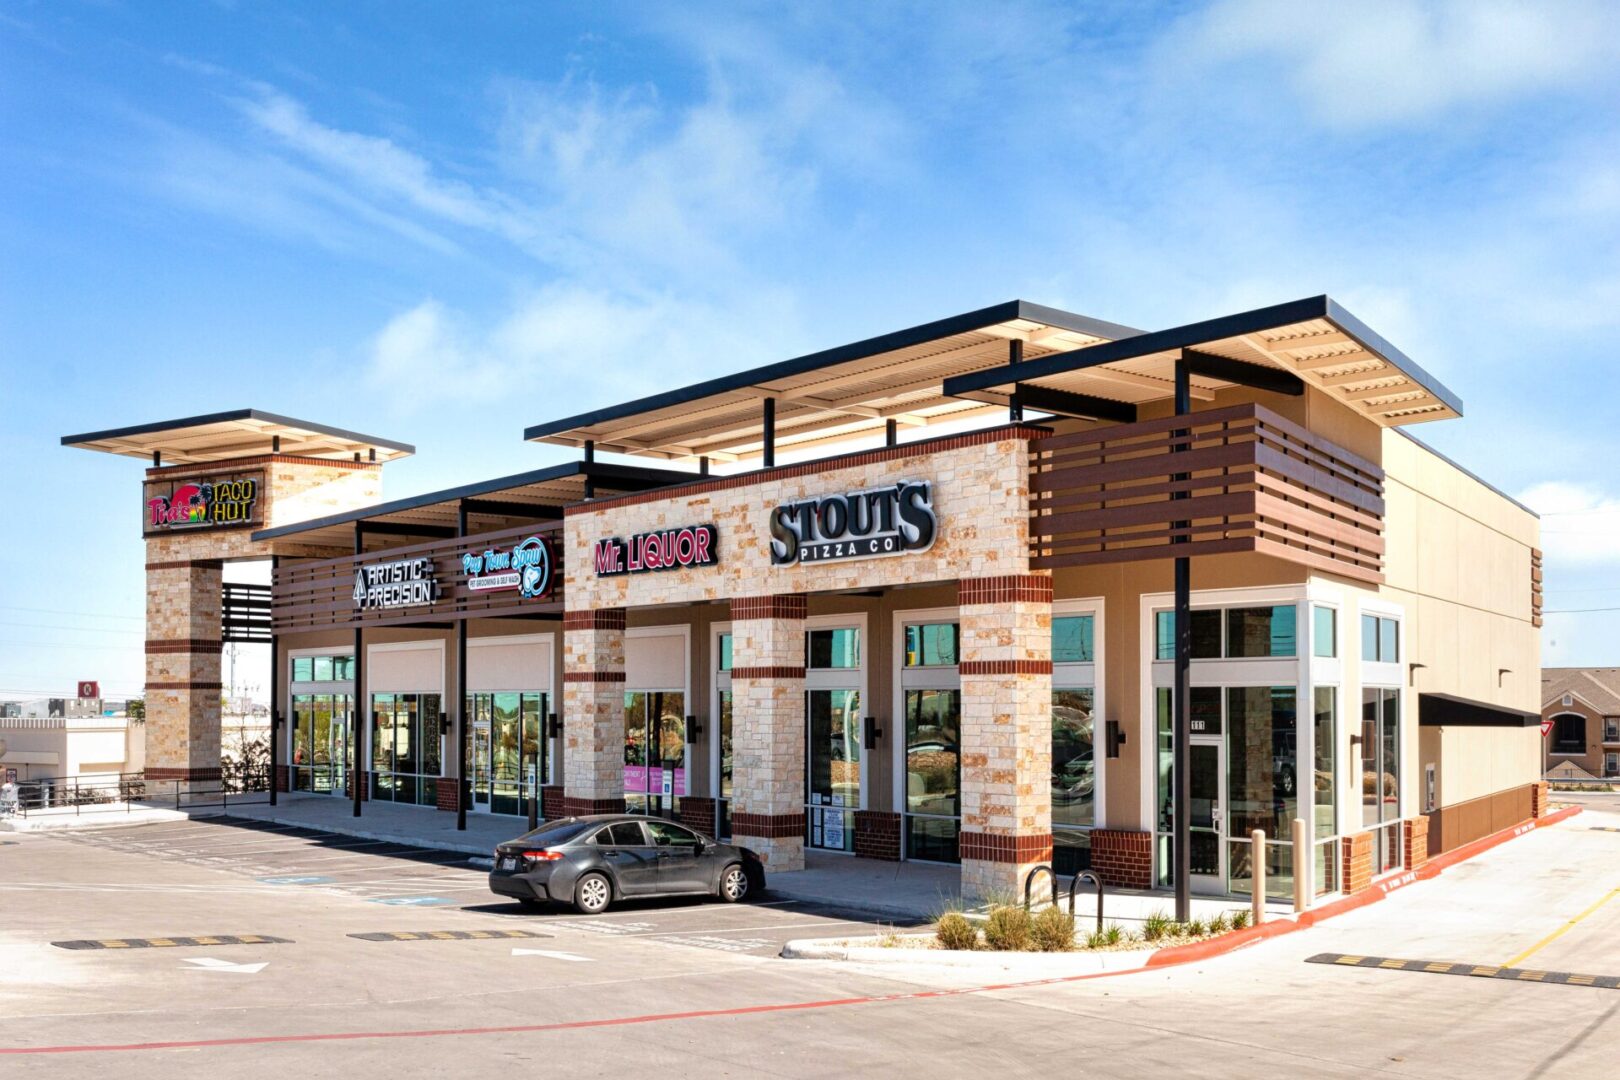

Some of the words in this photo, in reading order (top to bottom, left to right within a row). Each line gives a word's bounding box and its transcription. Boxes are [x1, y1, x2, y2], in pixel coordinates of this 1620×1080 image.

[213, 480, 252, 502] TACO
[147, 497, 191, 525] Tia's
[214, 501, 251, 521] HUT
[769, 481, 934, 566] STOUT'S
[463, 553, 482, 577] Pup
[484, 549, 510, 573] Town
[511, 545, 542, 571] Spaw
[593, 539, 623, 574] Mr.
[627, 527, 712, 570] LIQUOR
[800, 543, 857, 561] PIZZA
[869, 539, 894, 552] CO
[368, 560, 423, 586] ARTISTIC
[367, 580, 432, 607] PRECISION
